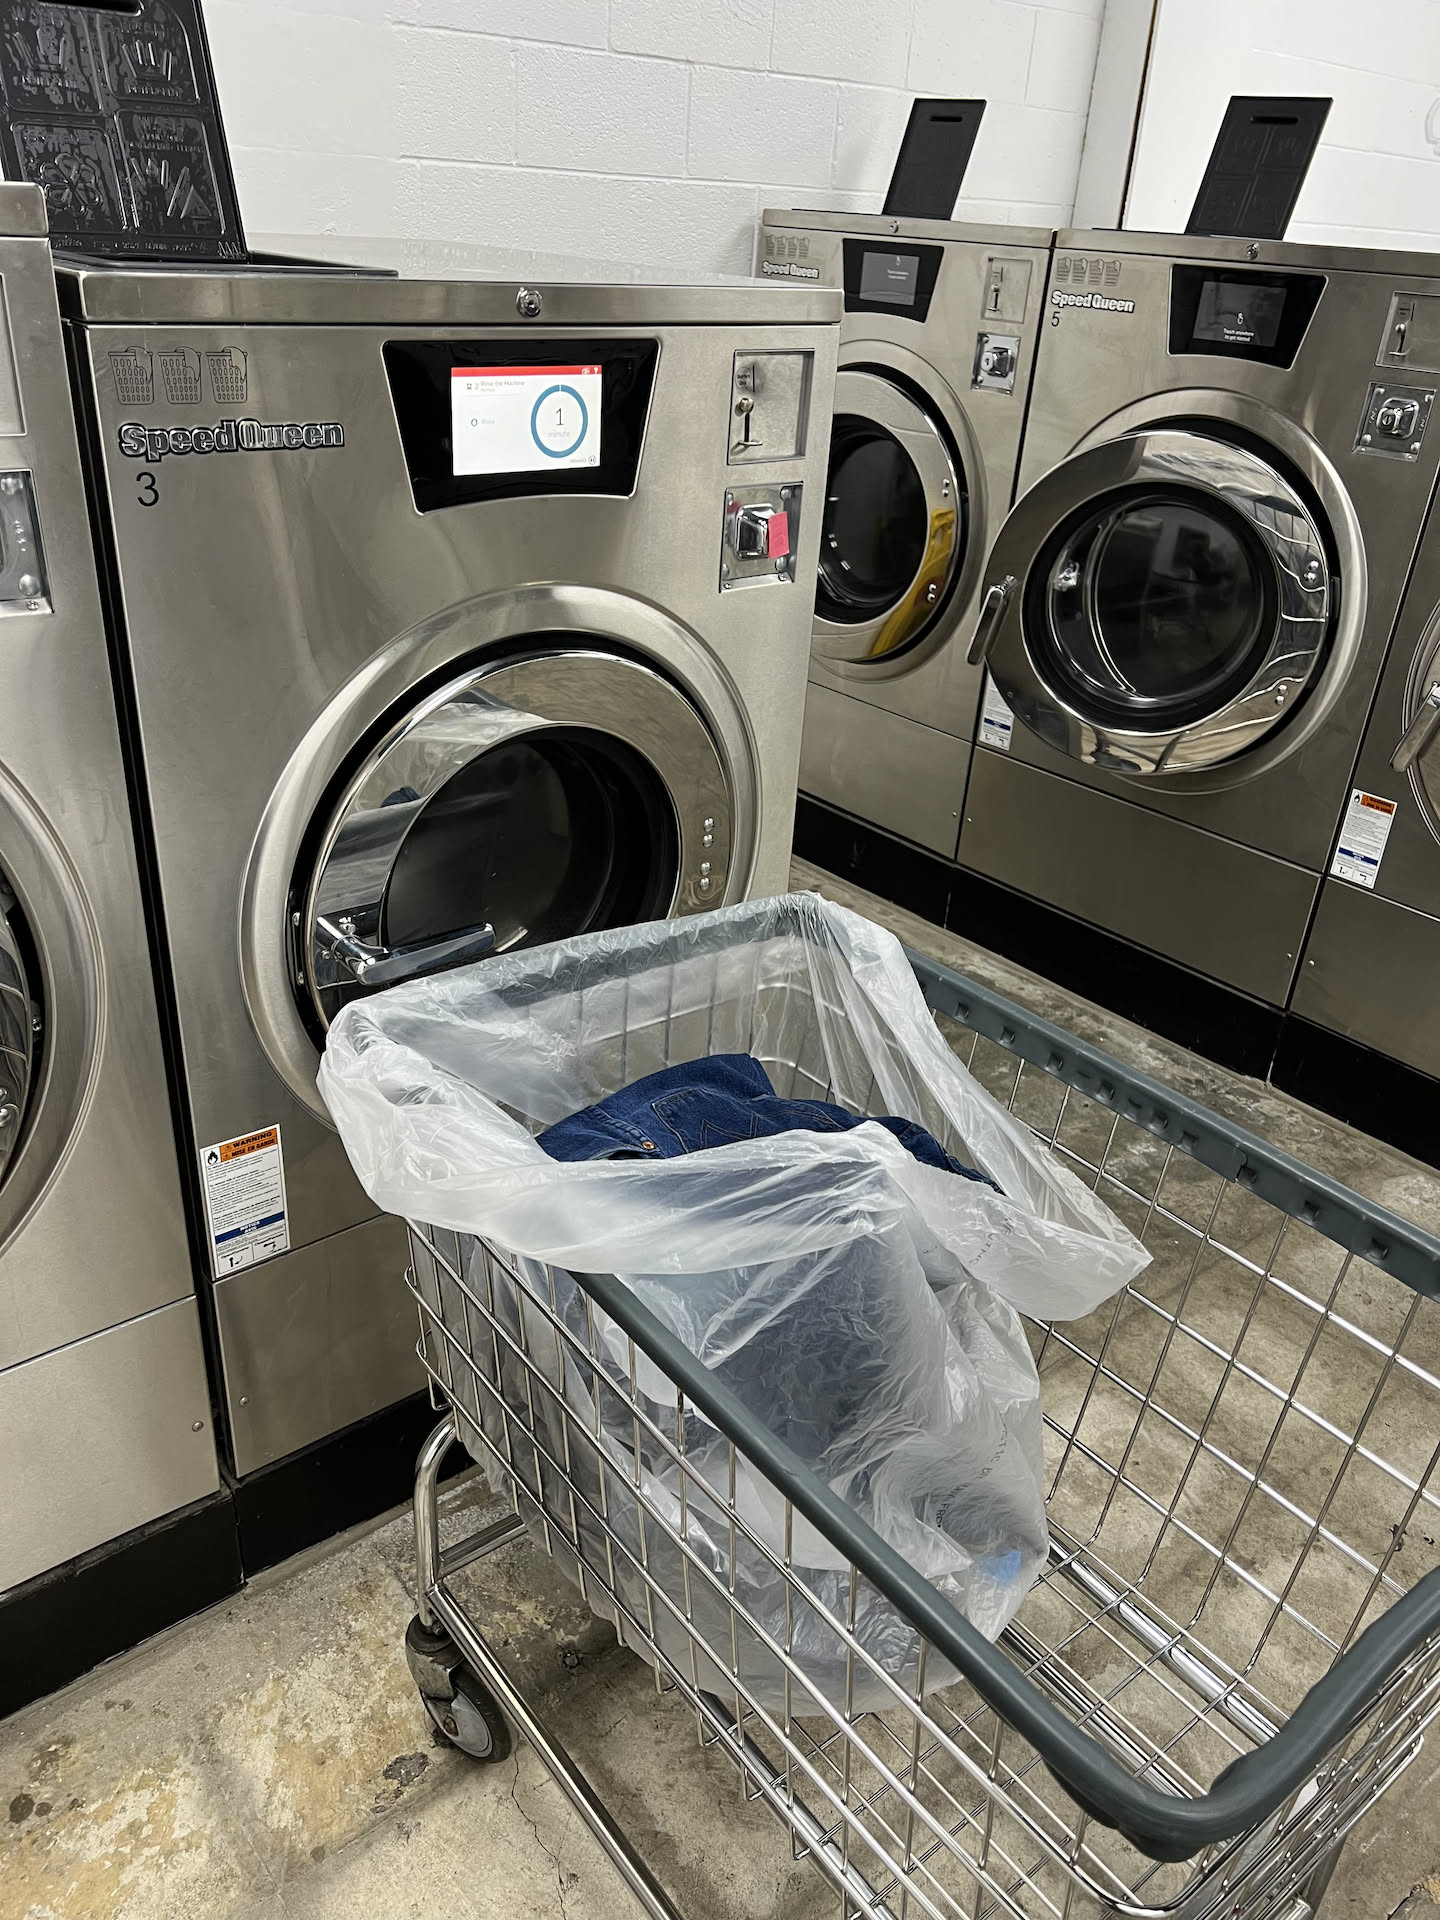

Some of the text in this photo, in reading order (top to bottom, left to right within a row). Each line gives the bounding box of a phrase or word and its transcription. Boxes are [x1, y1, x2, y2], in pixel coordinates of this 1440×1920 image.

[762, 261, 819, 279] Speed Queen
[1051, 290, 1135, 313] Speed Queen
[1051, 311, 1060, 327] 5
[555, 408, 564, 426] 1
[118, 418, 345, 462] Speed Queen
[548, 430, 570, 438] minute
[136, 472, 159, 506] 3
[232, 1131, 273, 1149] WARNING
[935, 1502, 950, 1529] FRO
